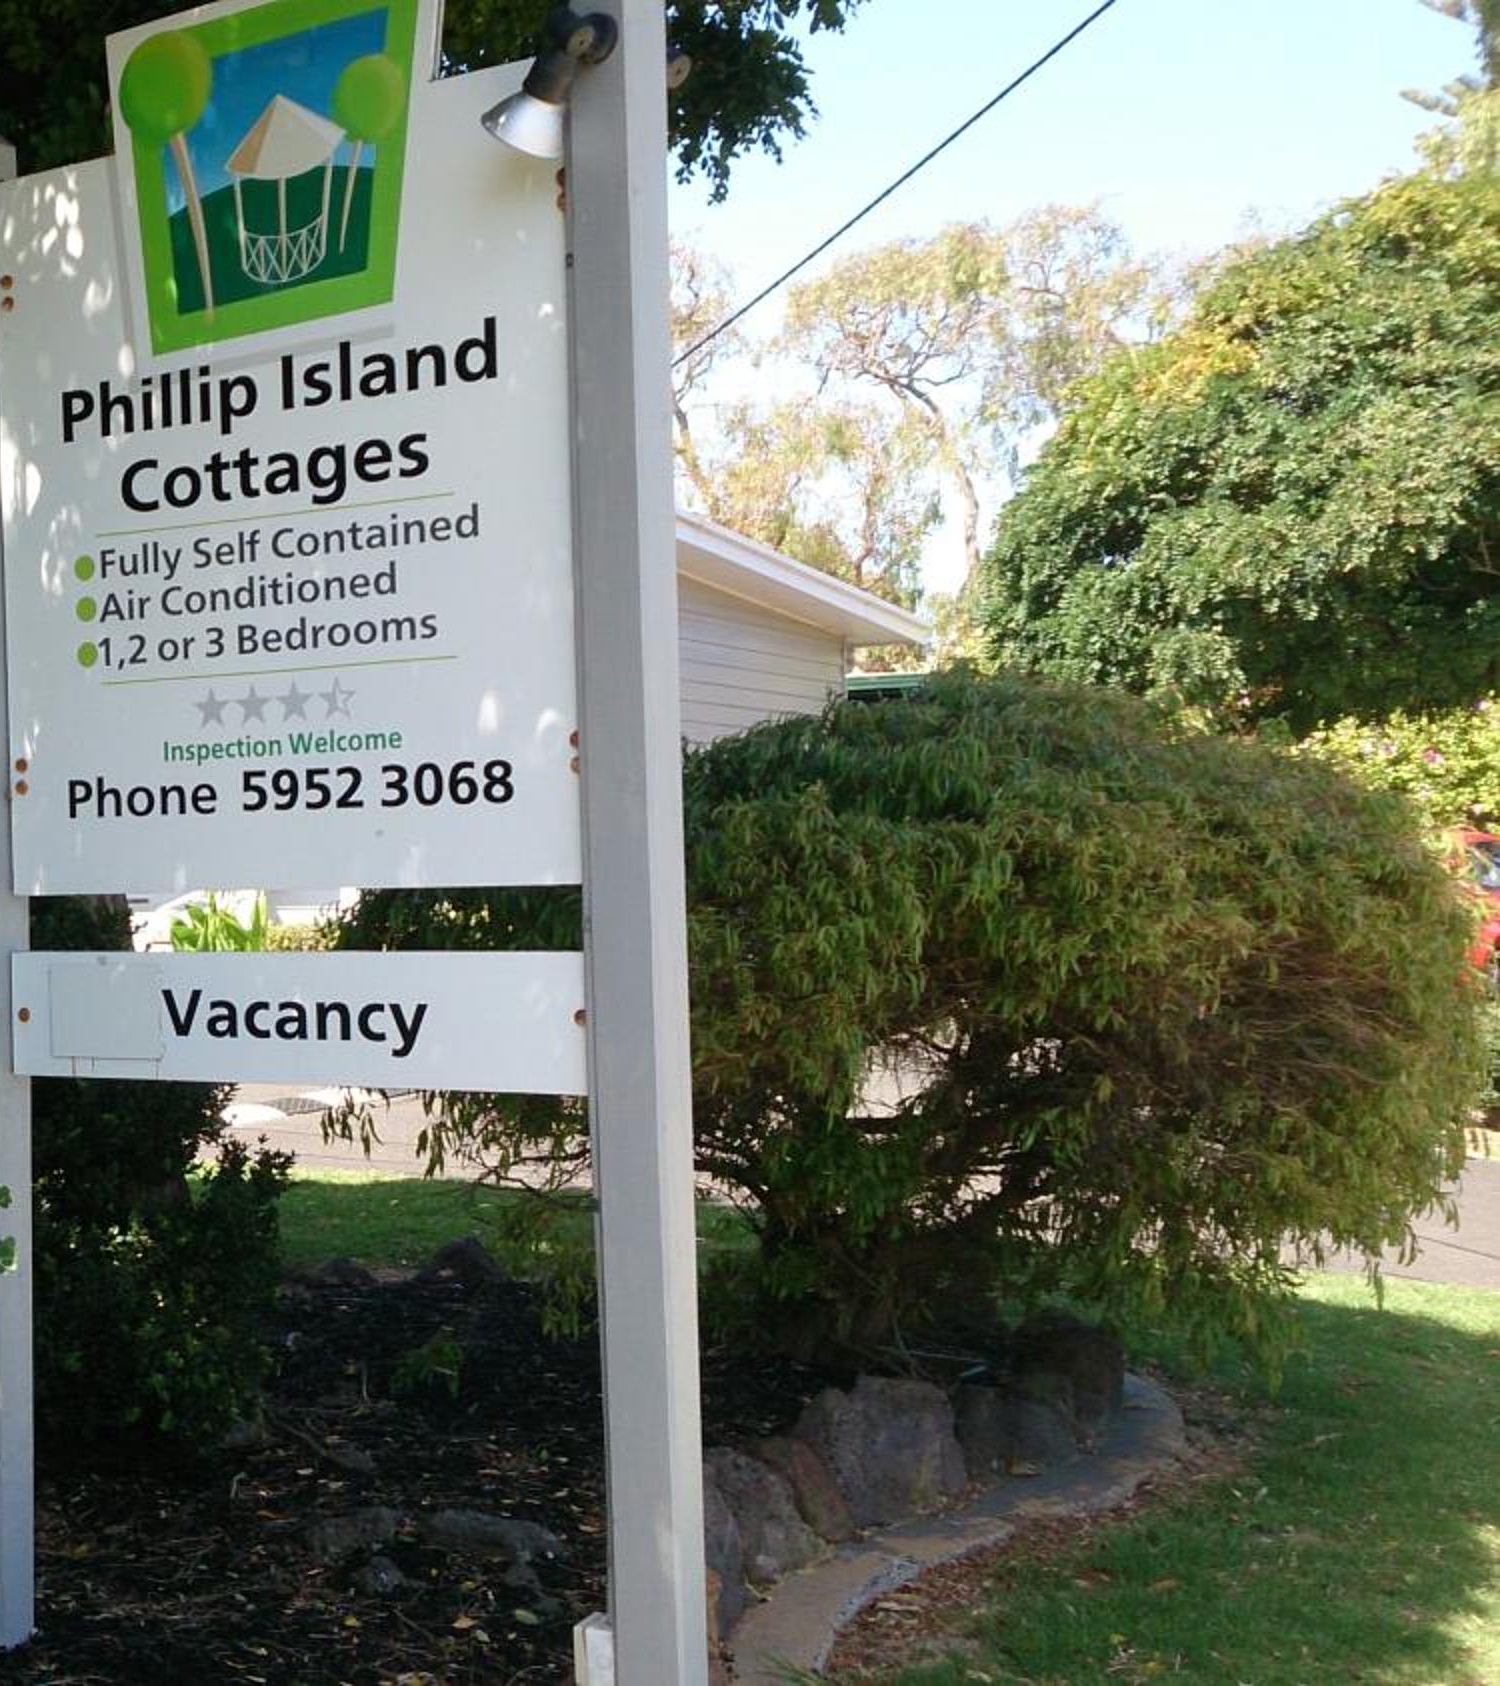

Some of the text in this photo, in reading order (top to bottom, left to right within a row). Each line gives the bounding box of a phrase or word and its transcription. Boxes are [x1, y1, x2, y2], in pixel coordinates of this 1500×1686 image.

[62, 316, 498, 444] Phillip Island
[121, 431, 429, 512] Cottages
[100, 503, 480, 581] Fully Self Contained
[100, 562, 397, 622] Air Conditioned
[158, 632, 195, 662] or
[205, 628, 225, 658] 3
[238, 612, 438, 655] Bedrooms
[164, 730, 402, 766] Inspection Welcome
[68, 759, 514, 818] Phone 5952 3068
[162, 989, 426, 1058] Vacancy
